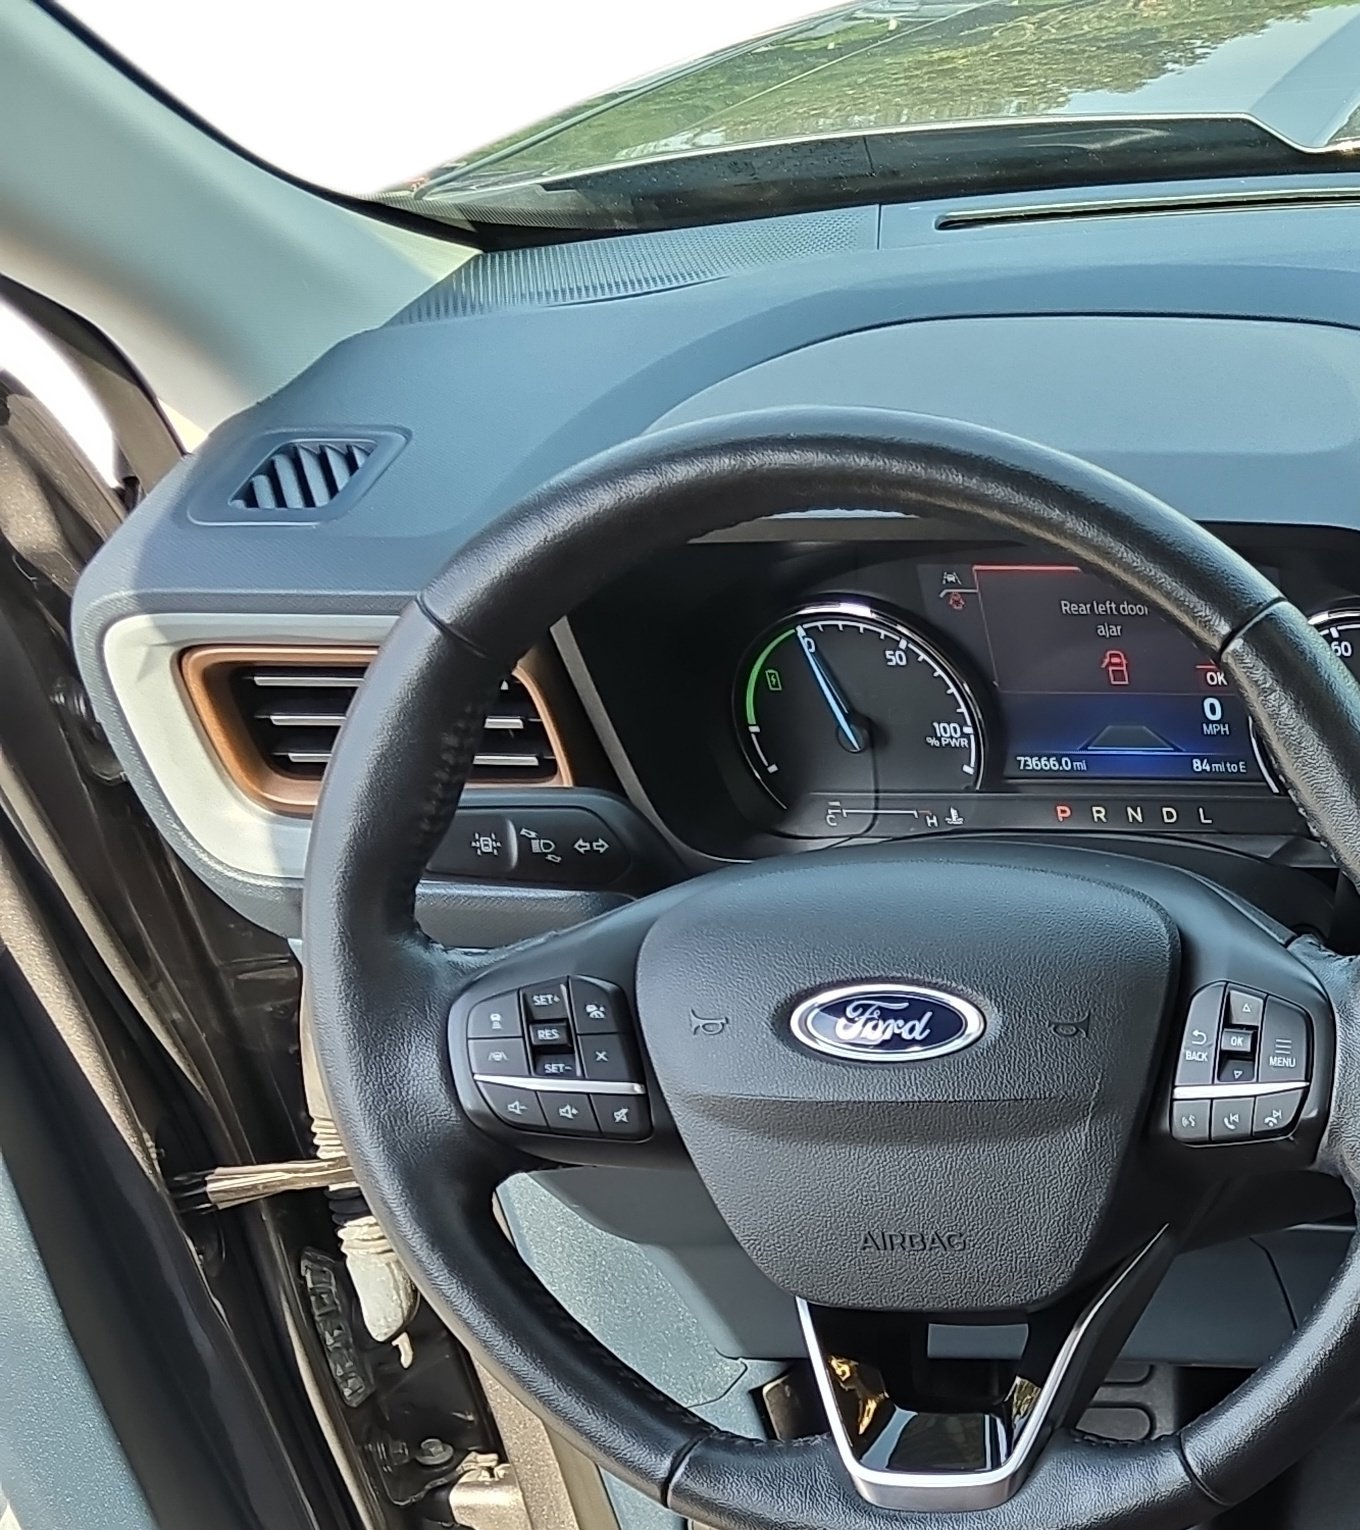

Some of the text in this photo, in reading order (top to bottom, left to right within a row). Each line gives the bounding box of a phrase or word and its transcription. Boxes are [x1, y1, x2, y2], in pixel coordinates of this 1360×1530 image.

[1061, 600, 1091, 615] Rear
[1093, 600, 1118, 615] left
[1097, 624, 1122, 639] ajar
[885, 650, 908, 667] 50
[1206, 671, 1228, 686] OK
[1203, 697, 1223, 721] 0
[932, 722, 961, 738] 100
[1202, 723, 1230, 736] MPH
[941, 738, 969, 749] PWR
[1016, 757, 1087, 771] 73666.0 mi
[1192, 758, 1247, 773] 84 mi to E
[826, 814, 837, 827] C
[926, 815, 939, 828] H
[1056, 805, 1213, 824] P R N D L
[835, 1000, 934, 1045] Ford
[537, 1029, 560, 1040] RES
[1230, 1036, 1244, 1047] OK
[1185, 1050, 1209, 1062] BACK
[1269, 1056, 1296, 1068] MENU
[860, 1231, 967, 1252] AIRBAG
